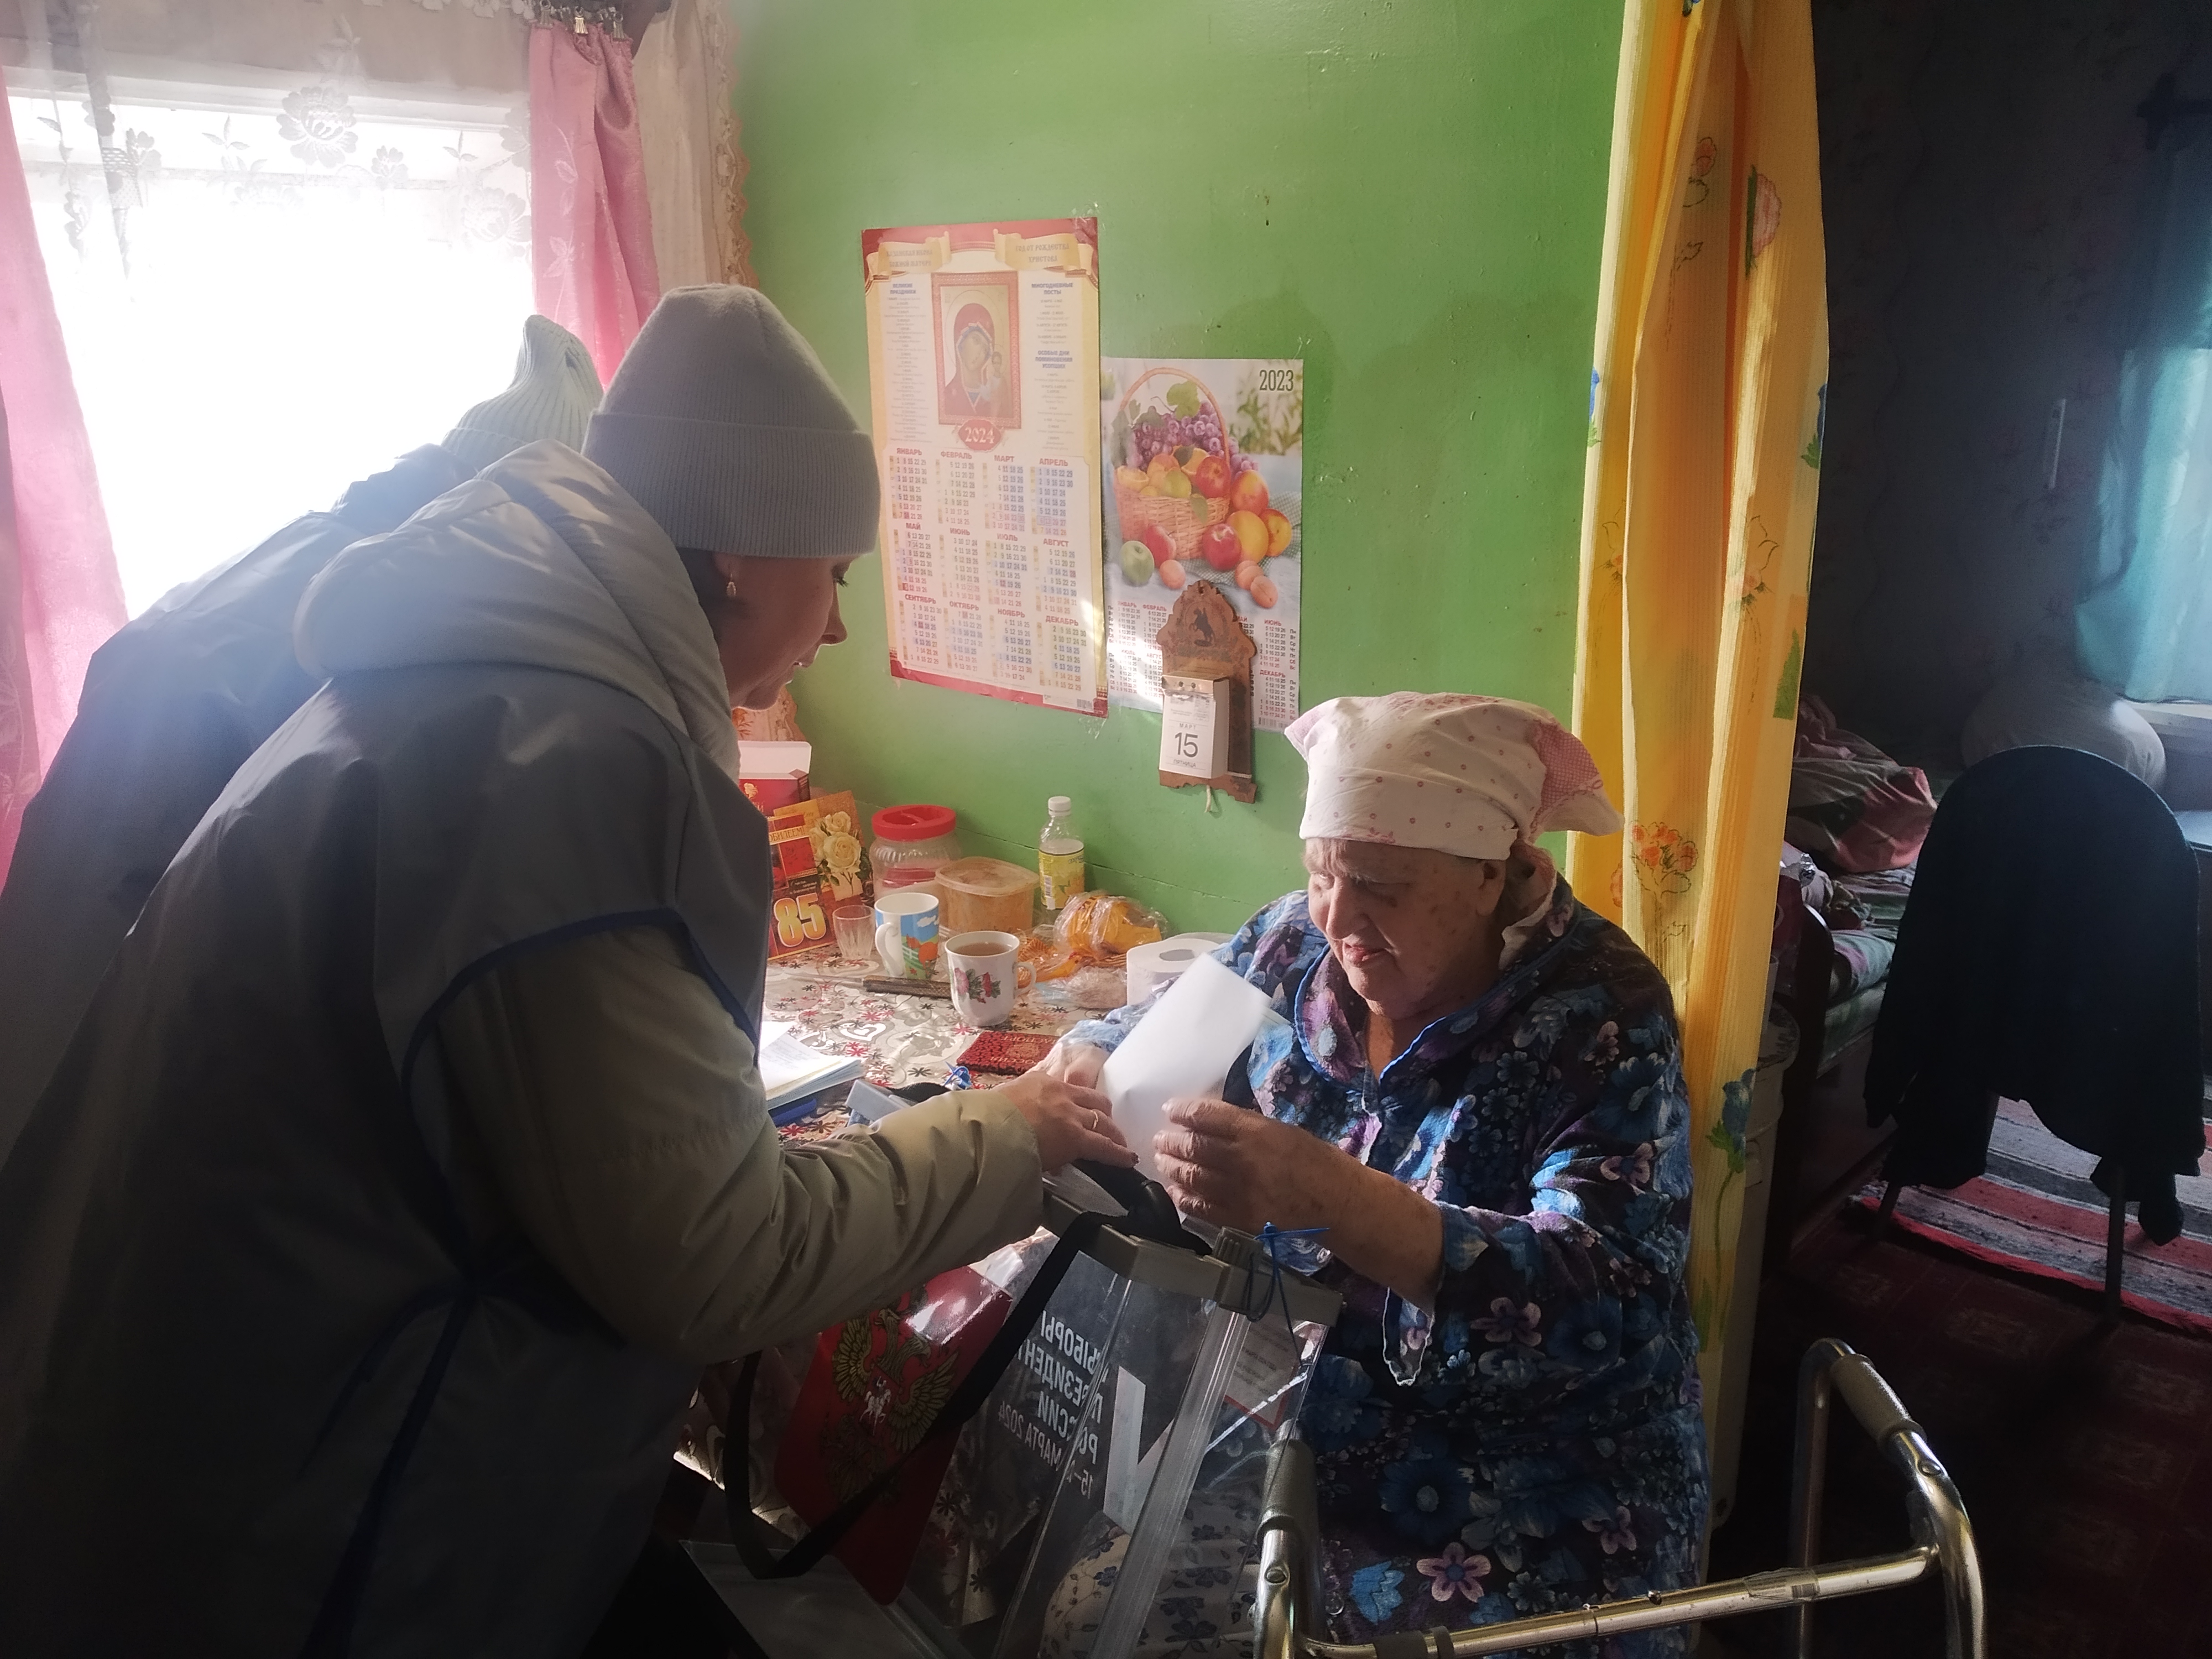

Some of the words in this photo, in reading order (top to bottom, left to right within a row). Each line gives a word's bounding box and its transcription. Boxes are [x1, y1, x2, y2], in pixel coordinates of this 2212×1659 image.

[1259, 369, 1294, 392] 2023
[964, 428, 995, 443] 2024
[941, 451, 972, 460] ФЕВРАЛЬ
[1040, 458, 1068, 467] АПРЕЛЬ
[1044, 538, 1069, 547] АВГУСТ
[905, 594, 936, 604] СЕНТЯБРЬ
[950, 601, 979, 611] ОКТЯБРЬ
[998, 608, 1025, 618] НОЯБРЬ
[1046, 615, 1079, 626] ДЕКАБРЬ
[1175, 732, 1198, 758] 15
[1173, 759, 1196, 768] ПЯТНИЦА
[774, 893, 826, 947] 85
[990, 1056, 1036, 1065] ОССИЯ
